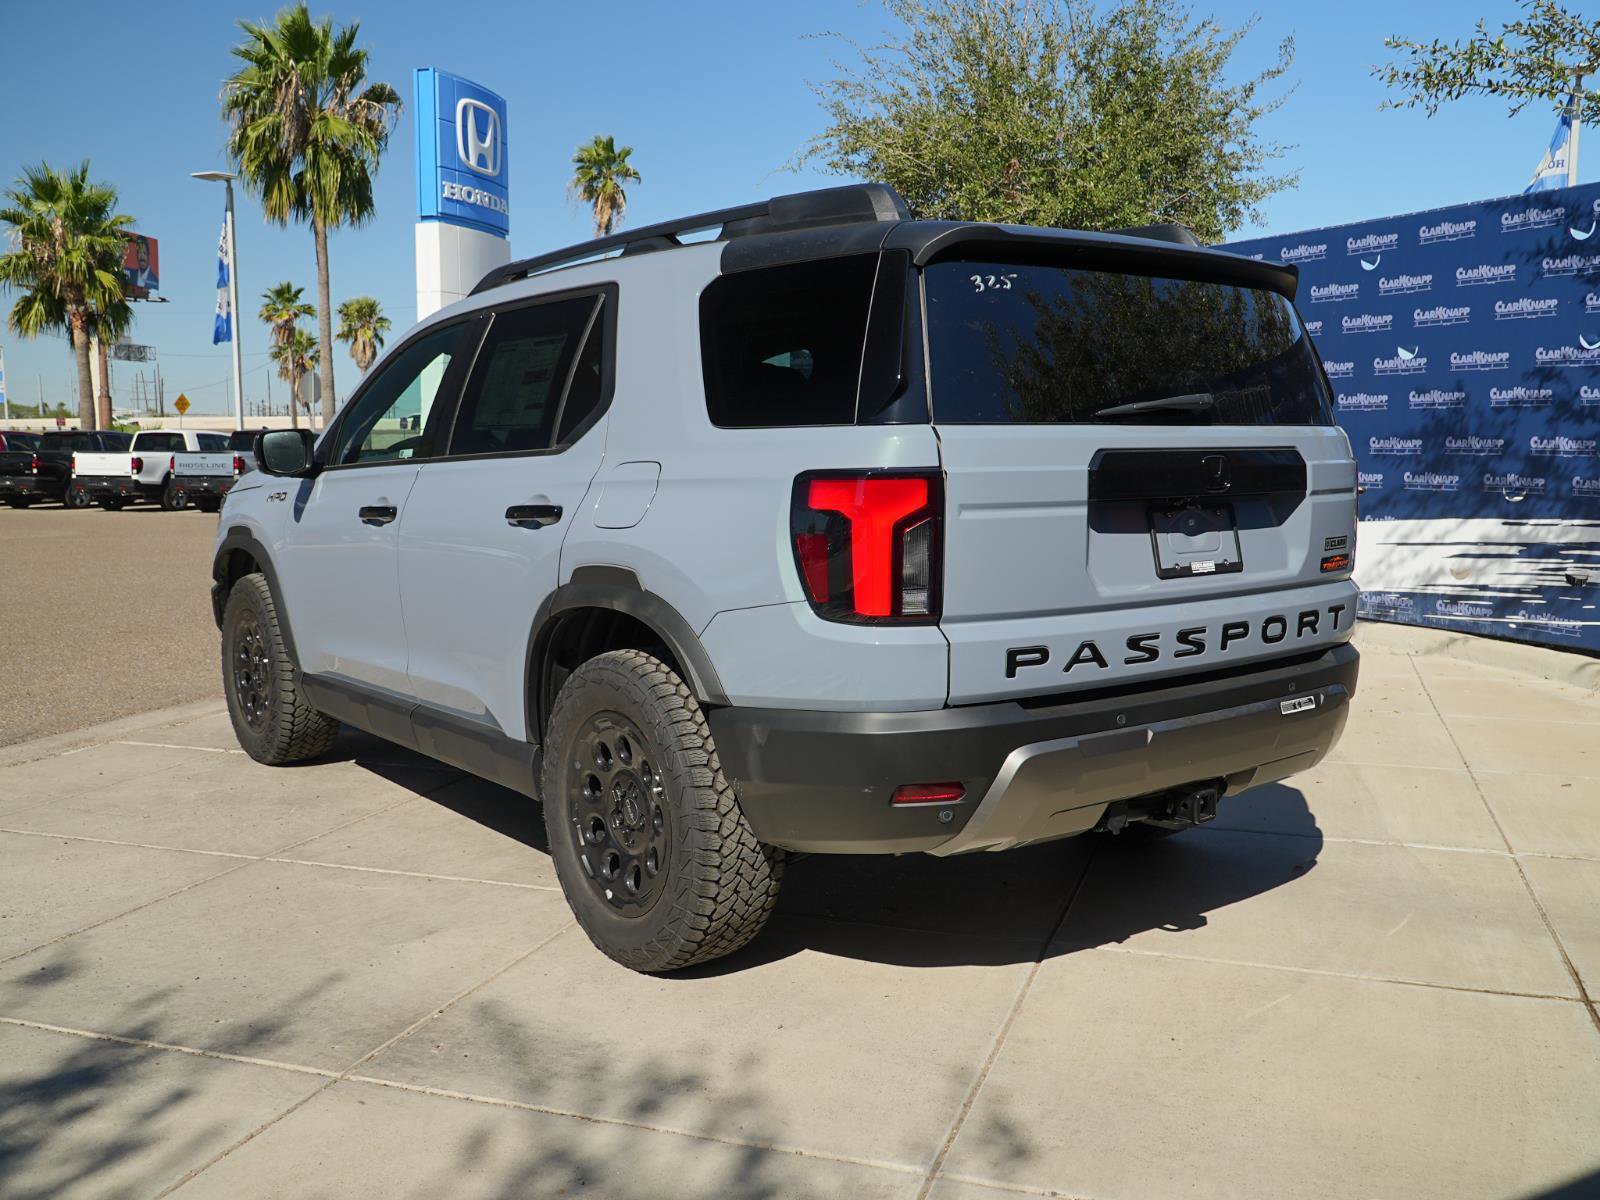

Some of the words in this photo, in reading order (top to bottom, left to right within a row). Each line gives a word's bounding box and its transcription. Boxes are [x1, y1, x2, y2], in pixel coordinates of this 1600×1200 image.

[442, 181, 508, 214] HONDA
[970, 274, 1018, 293] 325
[1005, 604, 1346, 678] PASSPORT
